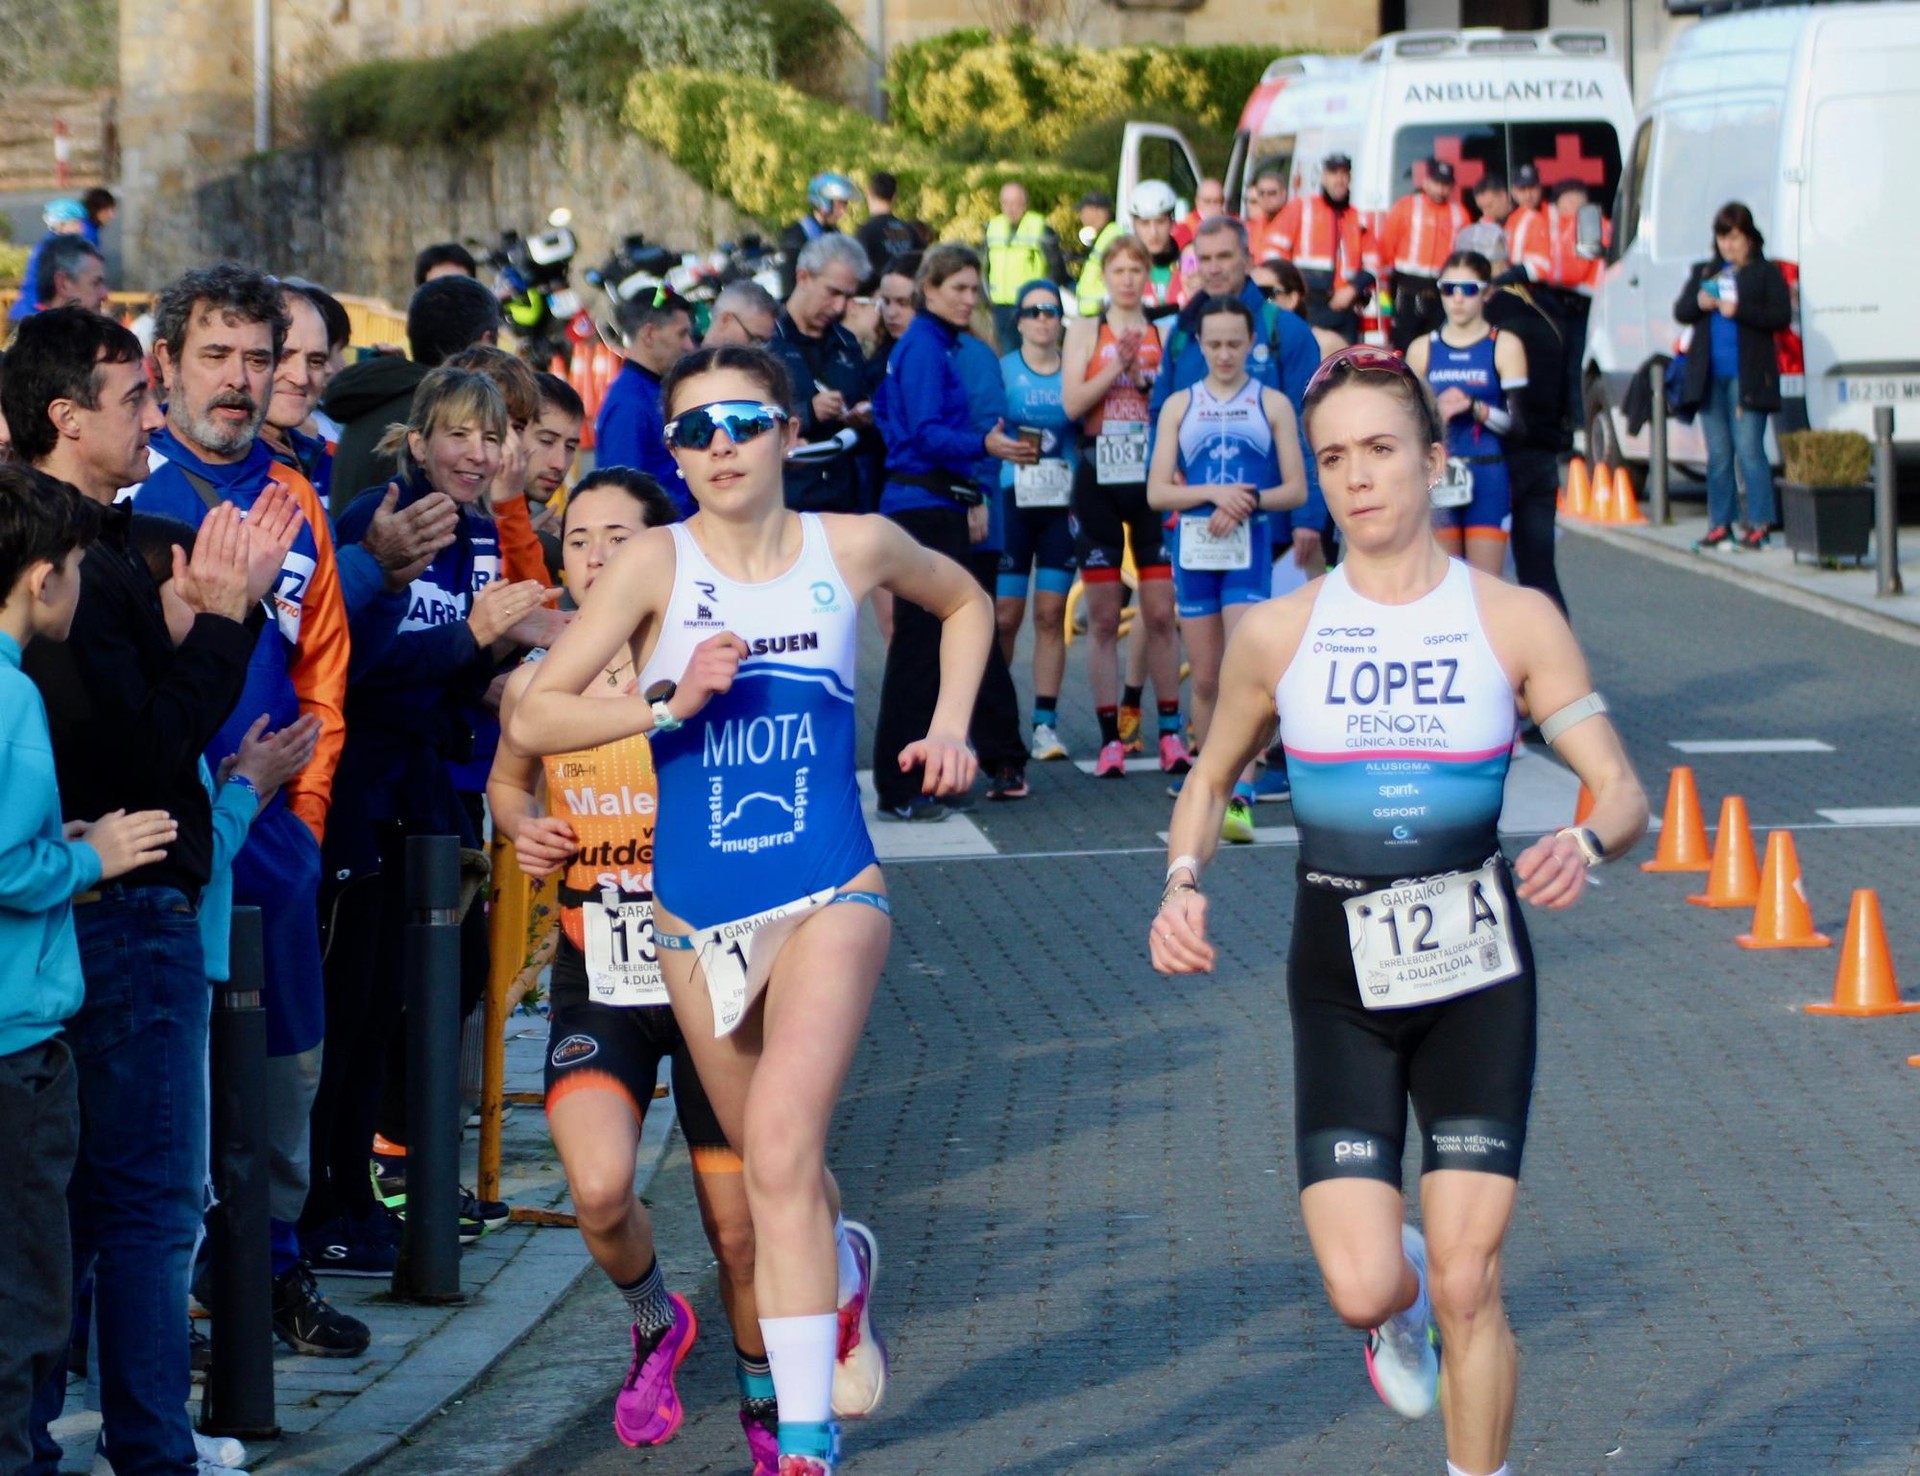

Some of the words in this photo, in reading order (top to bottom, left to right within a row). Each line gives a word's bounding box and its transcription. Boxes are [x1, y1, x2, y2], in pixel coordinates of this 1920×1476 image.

[1405, 79, 1603, 103] ANBULANTZIA
[1317, 627, 1376, 638] orca
[1423, 633, 1469, 646] GSPORT
[1324, 643, 1365, 654] Opteam
[1367, 645, 1378, 654] 10
[1324, 658, 1466, 706] LOPEZ
[1346, 710, 1446, 734] PEÑOTA
[703, 711, 817, 768] MIOTA
[1345, 735, 1396, 748] CLÍNICA
[1399, 737, 1449, 748] DENTAL
[1365, 762, 1431, 771] ALUSIGMA
[793, 767, 809, 832] taldea
[709, 775, 722, 848] triatloi
[1372, 806, 1426, 818] GSPORT
[722, 831, 795, 853] mugarra
[1380, 881, 1446, 907] GARAIKO
[1378, 903, 1440, 956] 12
[1467, 879, 1498, 935] A
[1379, 953, 1437, 969] ERRELEBOEN
[1396, 954, 1473, 982] 4.DUATLOIA
[1334, 1140, 1372, 1158] psi
